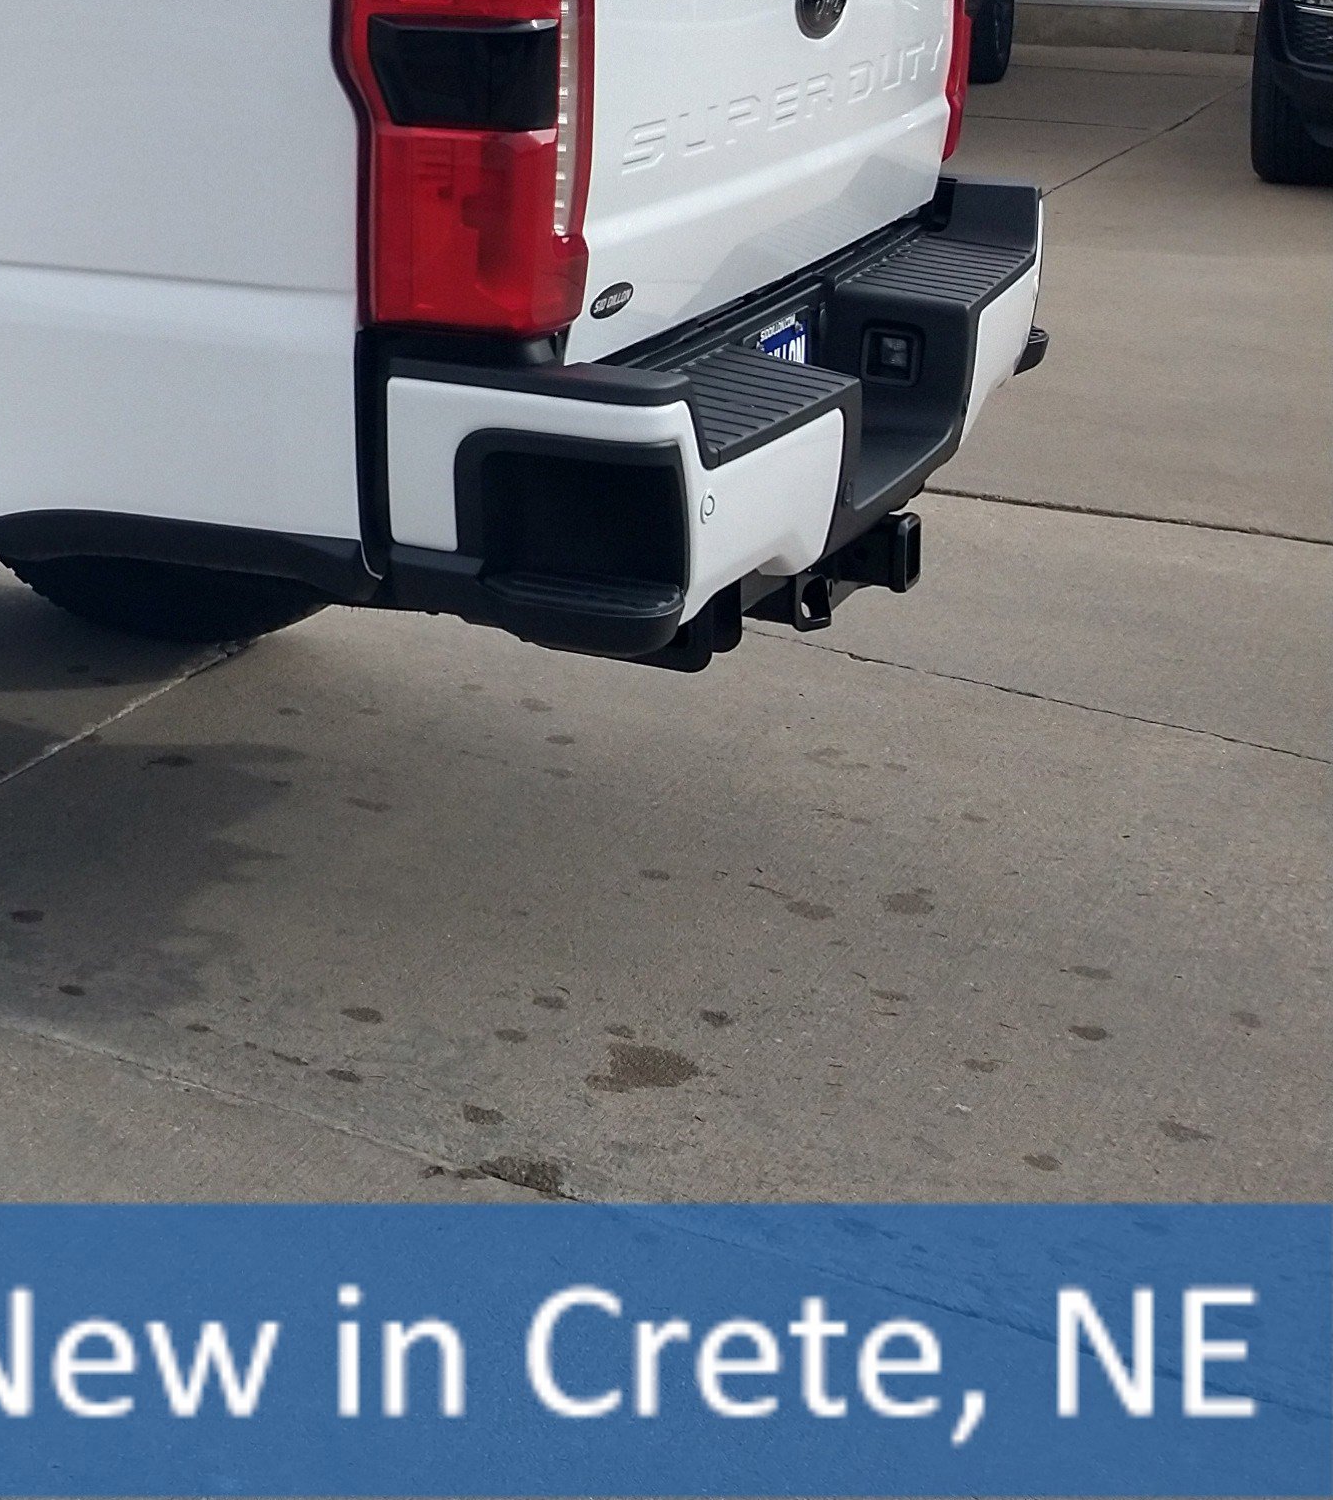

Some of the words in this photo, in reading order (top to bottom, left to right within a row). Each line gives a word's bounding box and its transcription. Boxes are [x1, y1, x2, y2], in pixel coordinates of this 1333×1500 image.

[621, 72, 835, 175] SUPER
[847, 34, 945, 104] DUTY
[593, 298, 608, 314] SID
